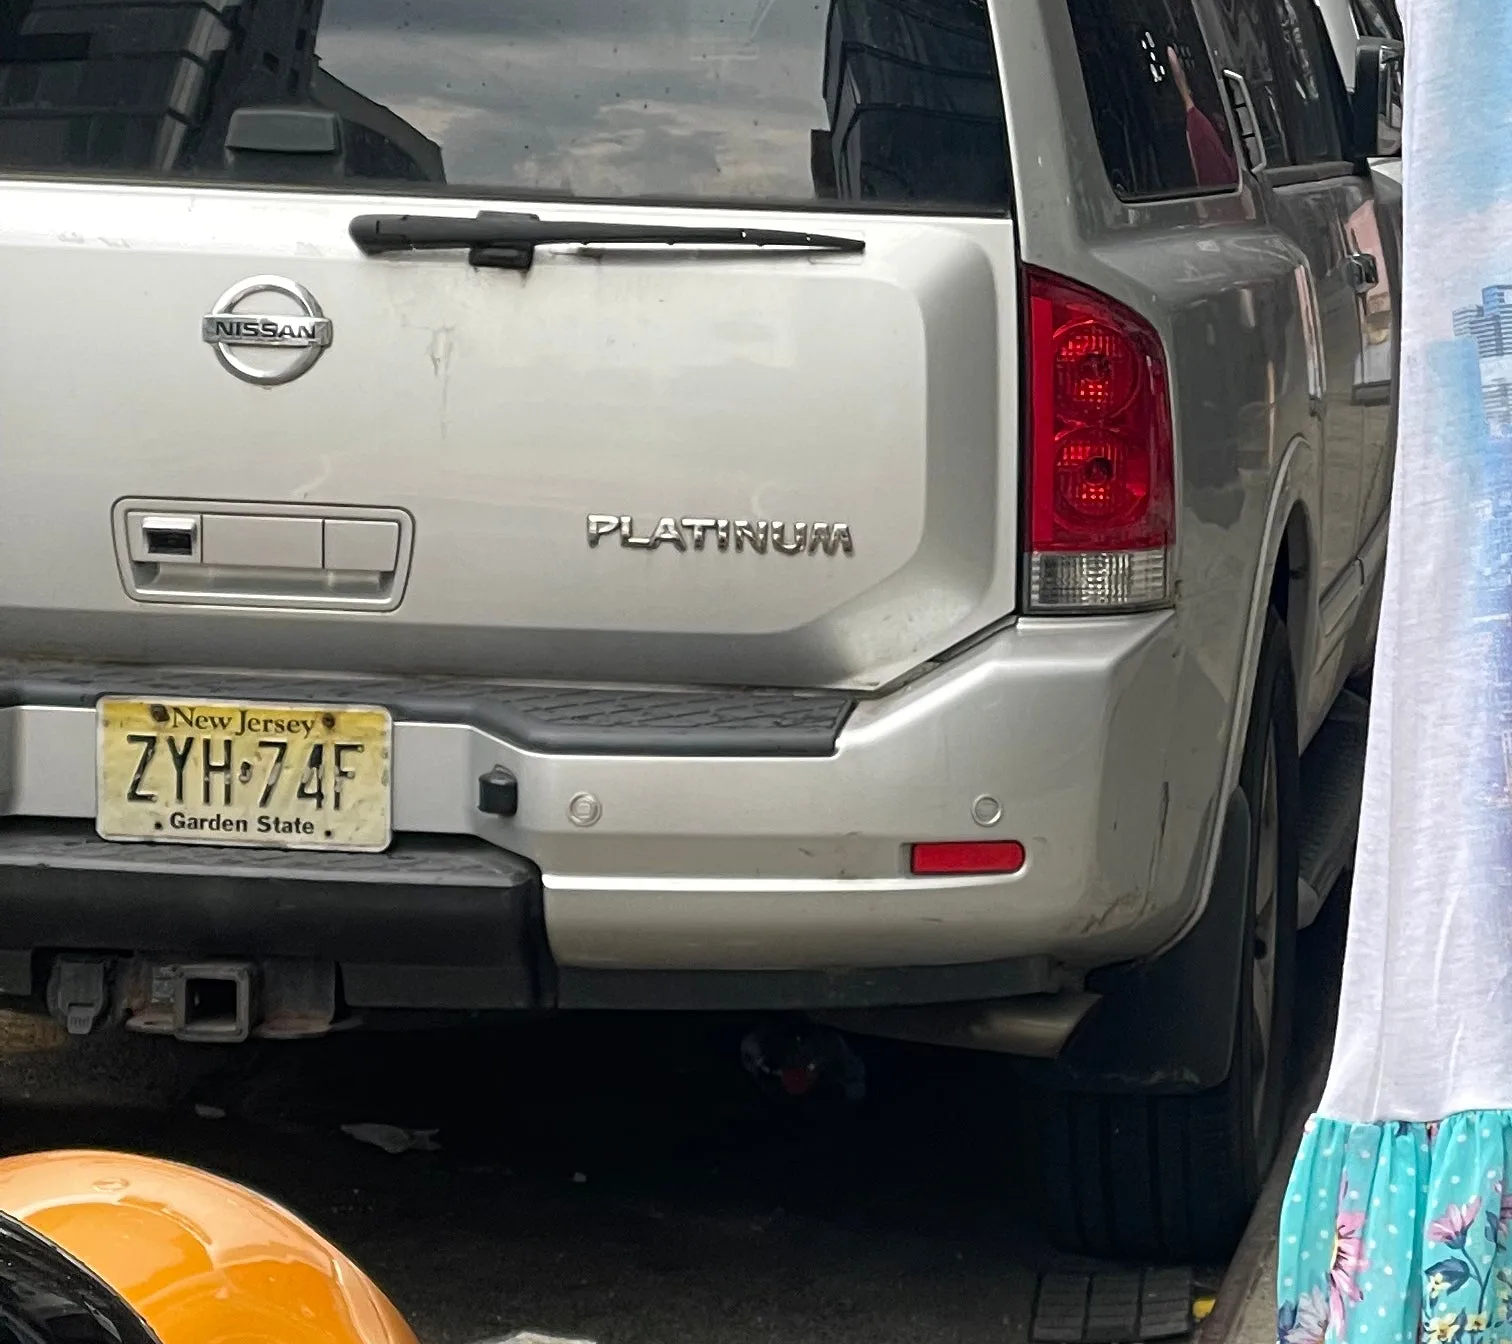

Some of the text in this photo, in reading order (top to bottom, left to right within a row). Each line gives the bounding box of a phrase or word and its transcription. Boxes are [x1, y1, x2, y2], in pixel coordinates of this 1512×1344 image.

[215, 320, 316, 340] NISSAN
[587, 513, 854, 555] PLATINUM
[171, 706, 316, 739] New Jersey
[170, 812, 315, 835] Garden State
